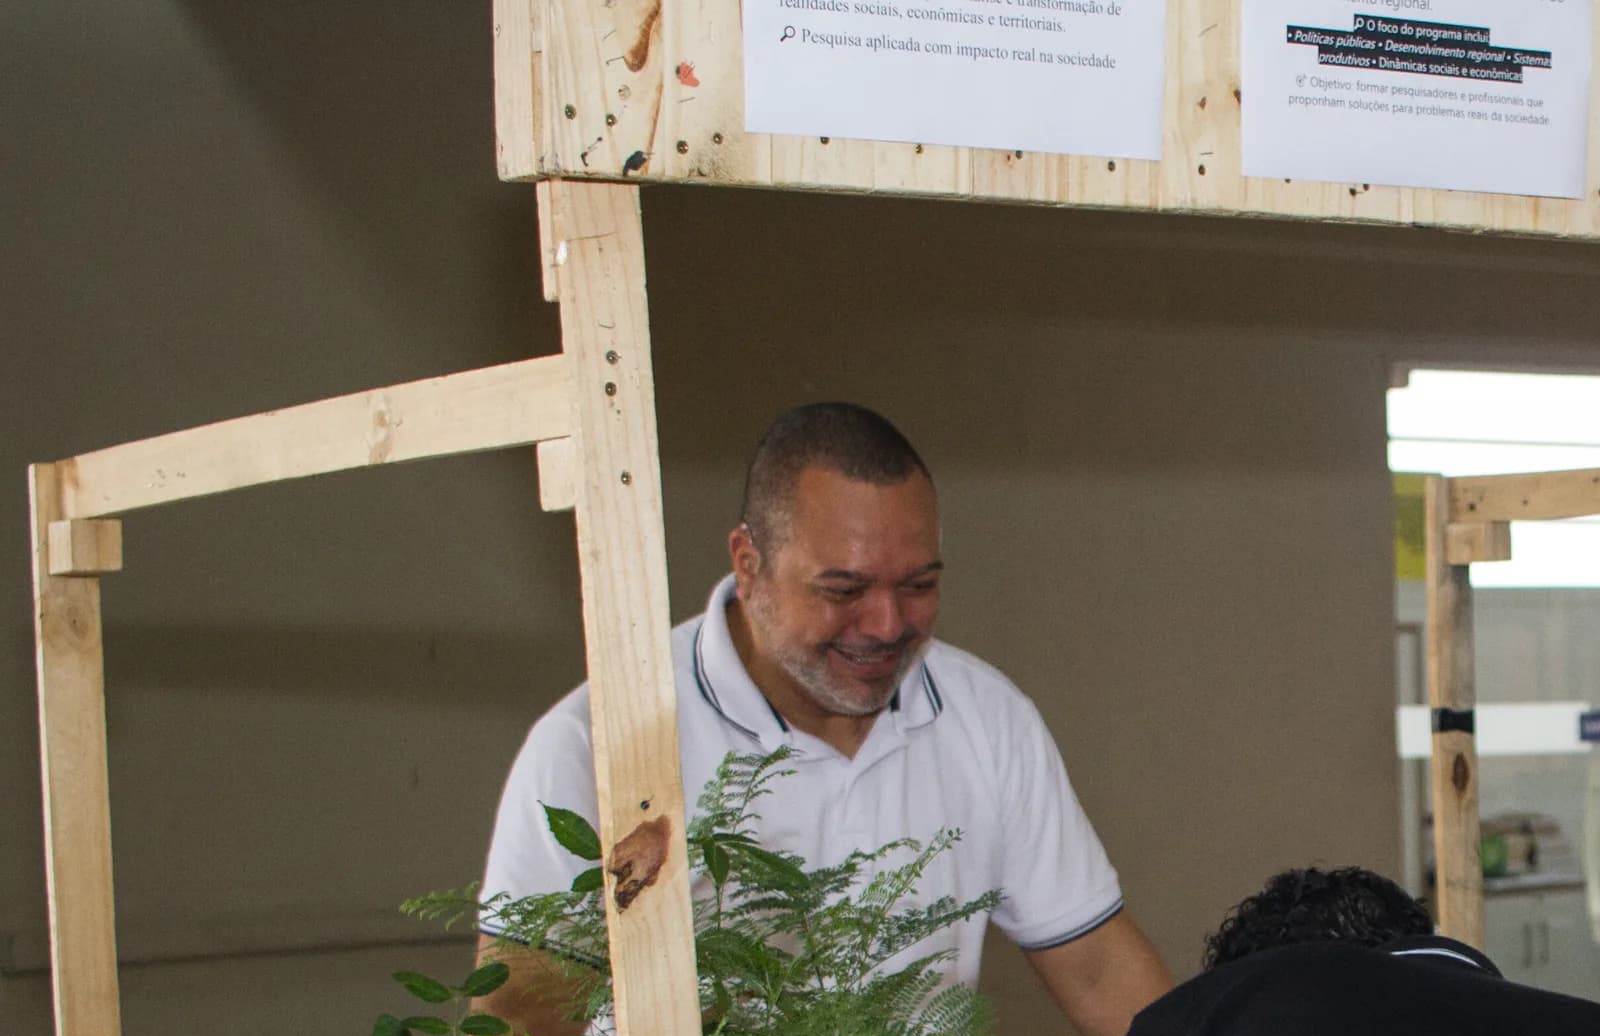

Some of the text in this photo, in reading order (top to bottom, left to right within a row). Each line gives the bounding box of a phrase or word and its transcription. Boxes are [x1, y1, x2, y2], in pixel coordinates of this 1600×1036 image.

[854, 2, 902, 18] sociais,
[907, 8, 984, 25] econômicas
[988, 16, 995, 25] e
[1000, 14, 1066, 32] territoriais.
[1107, 2, 1122, 16] de
[1367, 19, 1376, 31] O
[1378, 21, 1398, 34] foco
[1400, 23, 1413, 35] do
[1416, 27, 1462, 41] programa
[802, 28, 1116, 69] Pesquisa aplicada com impacto real na sociedade
[1294, 30, 1334, 46] Políticas
[1335, 34, 1376, 49] públicas
[1385, 40, 1465, 58] Desenvolvimento
[1467, 48, 1506, 62] regional
[1319, 52, 1522, 81] produtivos Dinâmicas sociais e econômicas
[1289, 95, 1345, 108] proponham
[1348, 98, 1390, 112] soluções
[1392, 103, 1413, 115] para
[1416, 104, 1465, 119] problemas
[1356, 81, 1388, 95] formar
[1391, 86, 1458, 100] pesquisadores
[1460, 92, 1466, 101] e
[1468, 92, 1524, 106] profissionais
